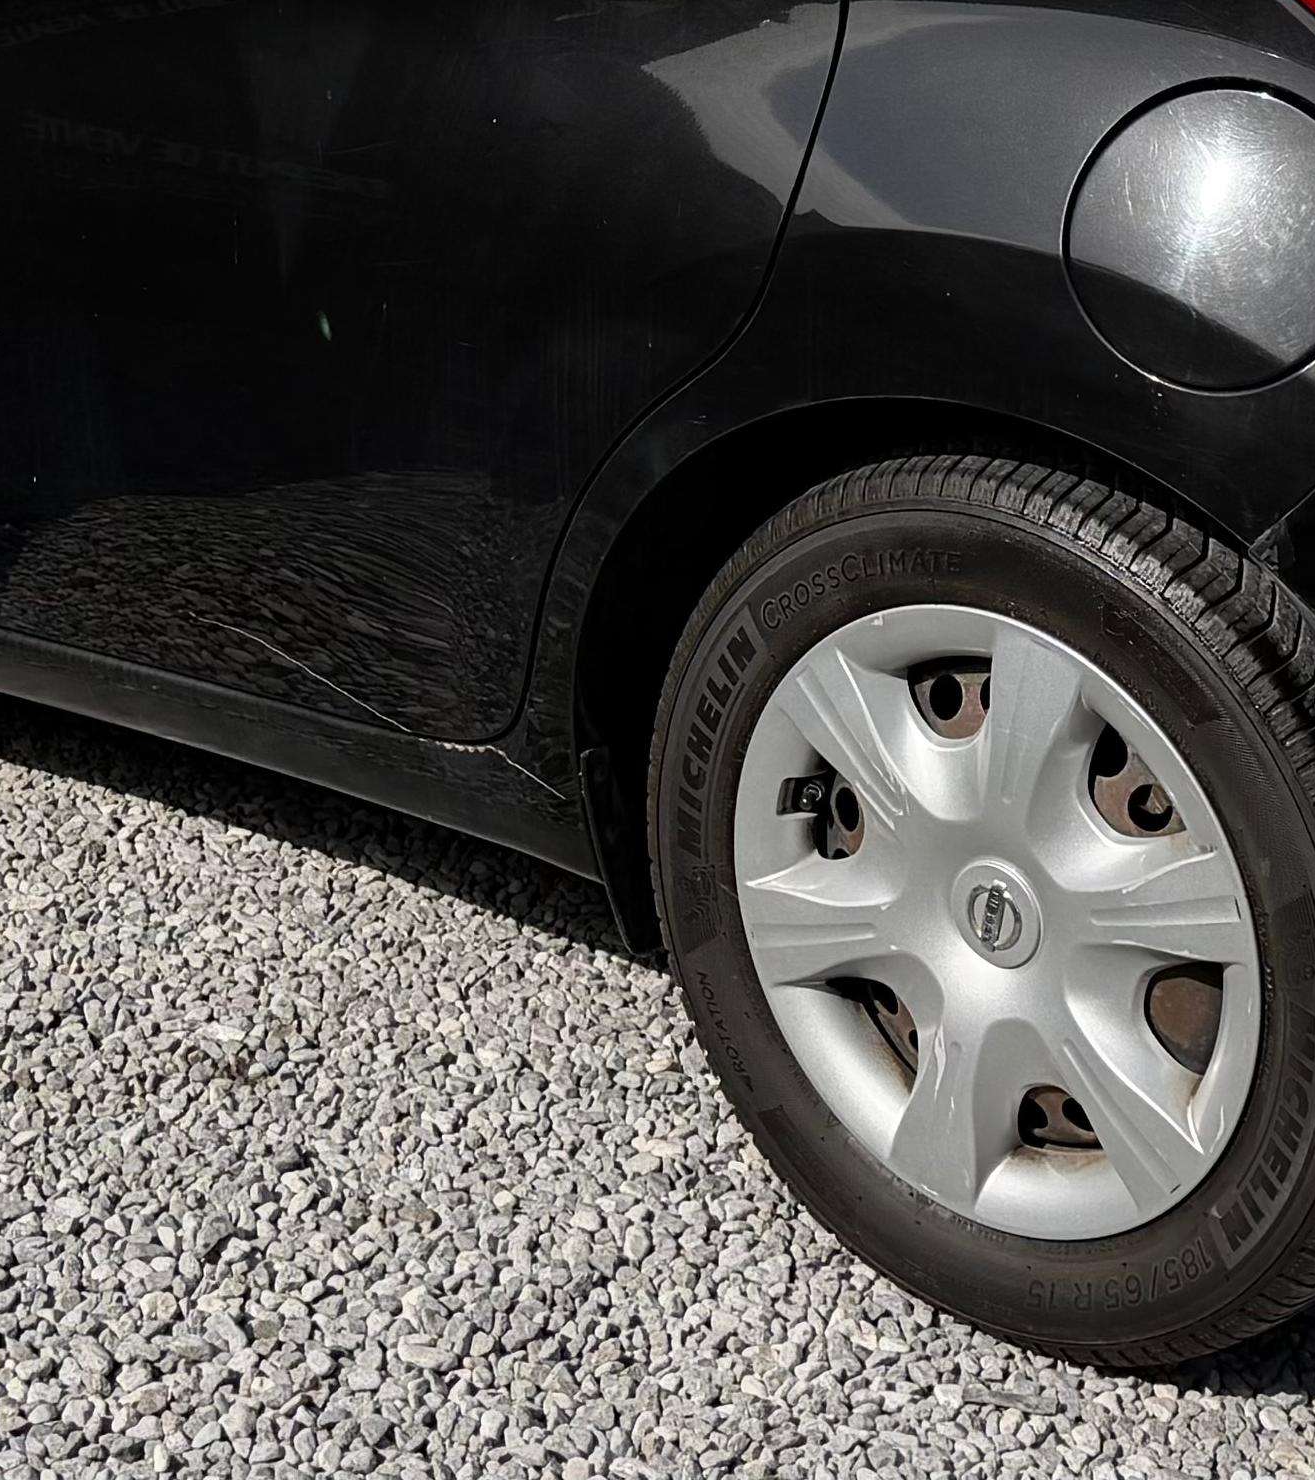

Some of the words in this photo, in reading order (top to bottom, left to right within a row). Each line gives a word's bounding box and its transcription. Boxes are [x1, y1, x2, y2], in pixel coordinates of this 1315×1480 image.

[675, 623, 760, 860] MICHELIN
[1027, 1278, 1057, 1308] 15
[1073, 1282, 1094, 1311] R
[1104, 1236, 1213, 1311] 185/65
